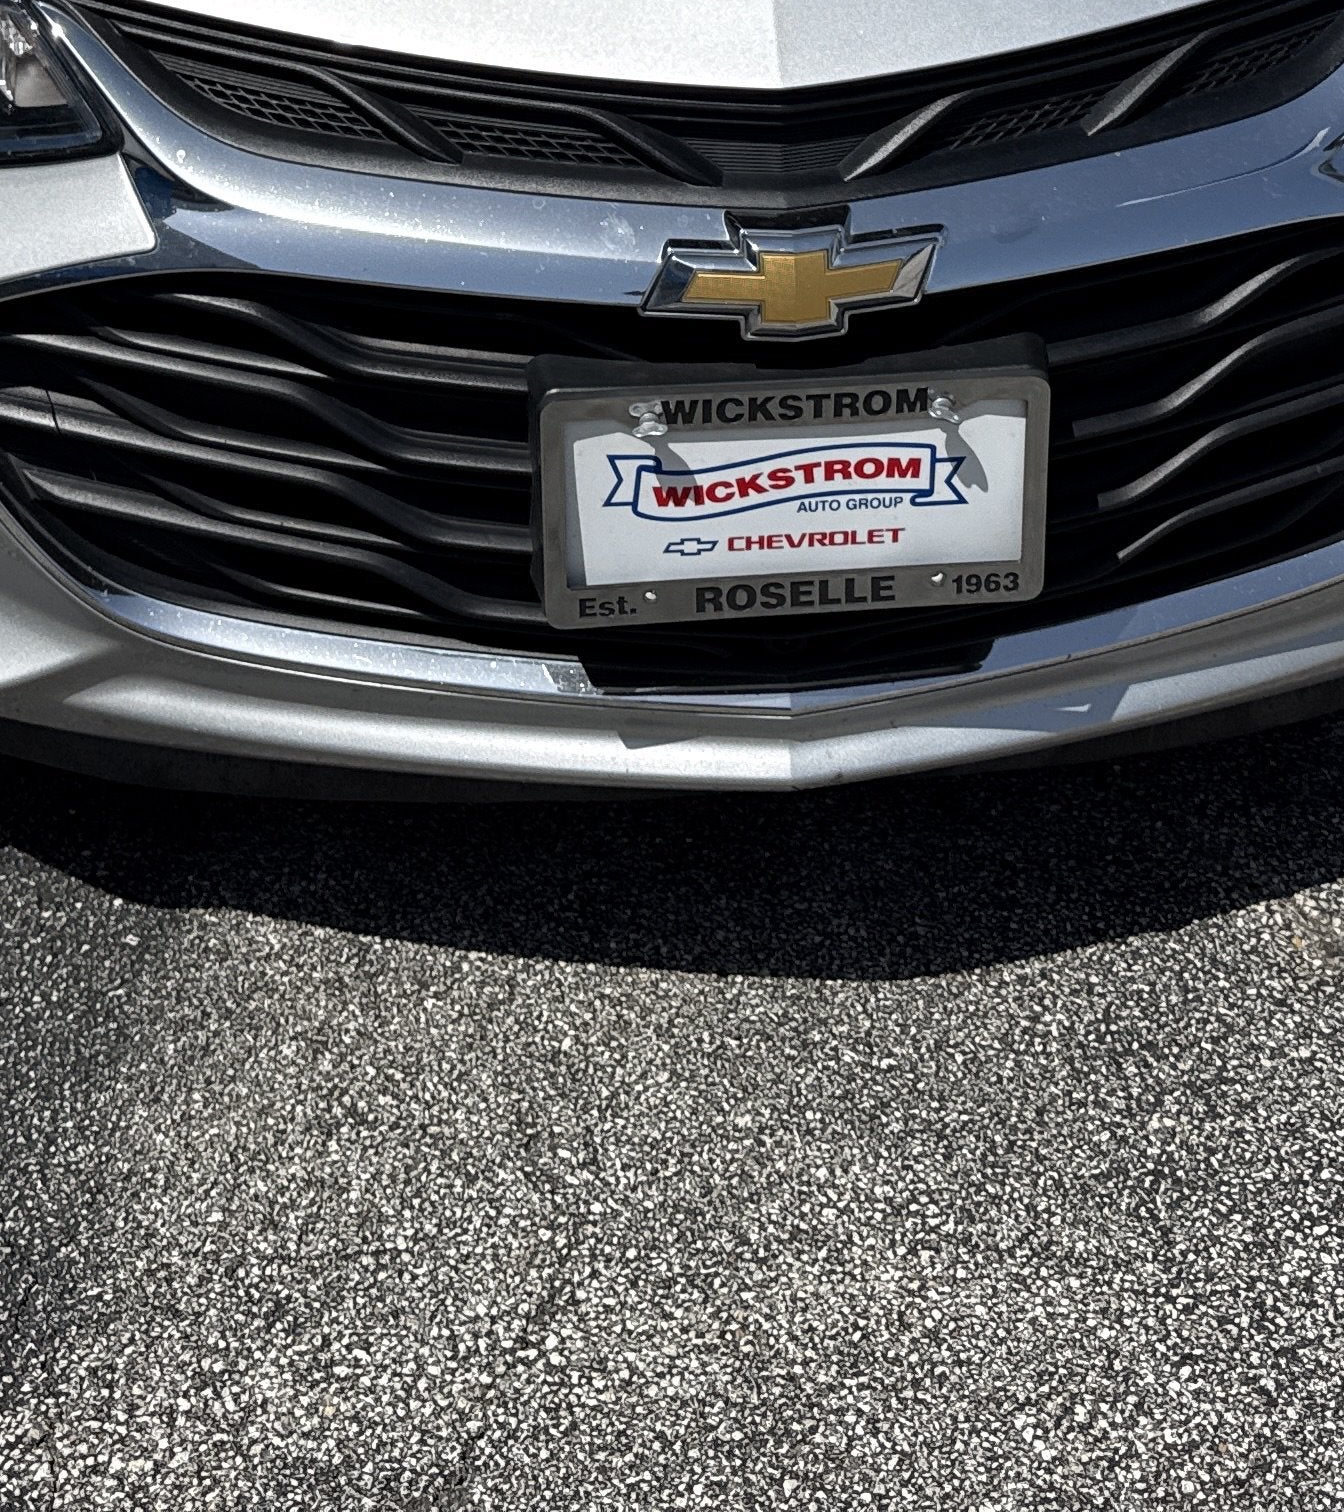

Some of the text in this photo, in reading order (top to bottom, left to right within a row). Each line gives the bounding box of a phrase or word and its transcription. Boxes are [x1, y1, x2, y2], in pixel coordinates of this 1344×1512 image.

[661, 387, 929, 425] WICKSTROM
[652, 457, 922, 507] WICKSTROM
[797, 496, 904, 513] AUTO GROUP
[727, 528, 906, 552] CHEVROLET
[578, 571, 1020, 619] Est. ROSELLE 1963
